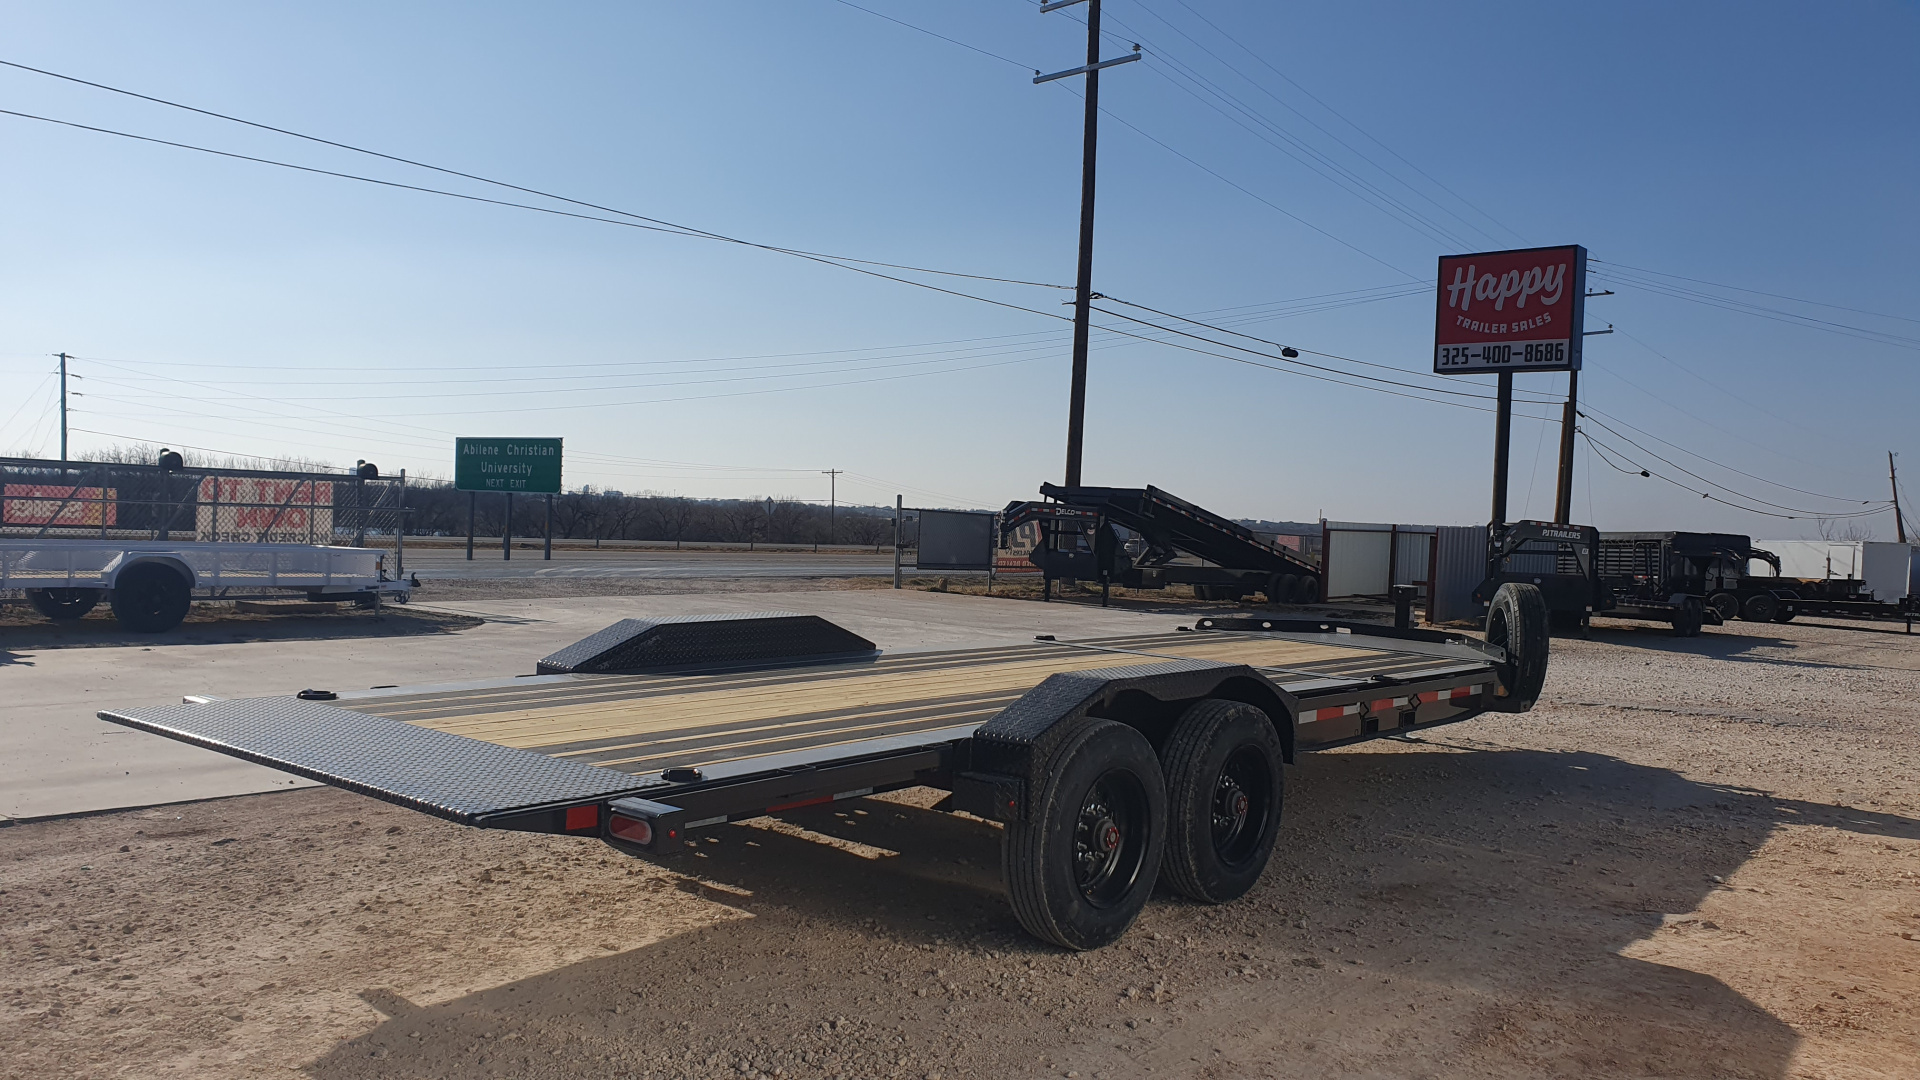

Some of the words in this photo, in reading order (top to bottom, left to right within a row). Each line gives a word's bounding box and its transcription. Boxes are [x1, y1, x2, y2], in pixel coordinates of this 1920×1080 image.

[1446, 263, 1567, 311] Happy
[1456, 315, 1507, 334] TRAILER
[1511, 312, 1552, 333] SALES
[1441, 343, 1564, 366] 325-400-8686
[463, 443, 499, 456] Abilene
[506, 443, 555, 456] Christian
[480, 461, 533, 477] University
[485, 478, 504, 488] NEXT
[510, 479, 526, 488] EXIT
[1056, 508, 1075, 516] DELCO
